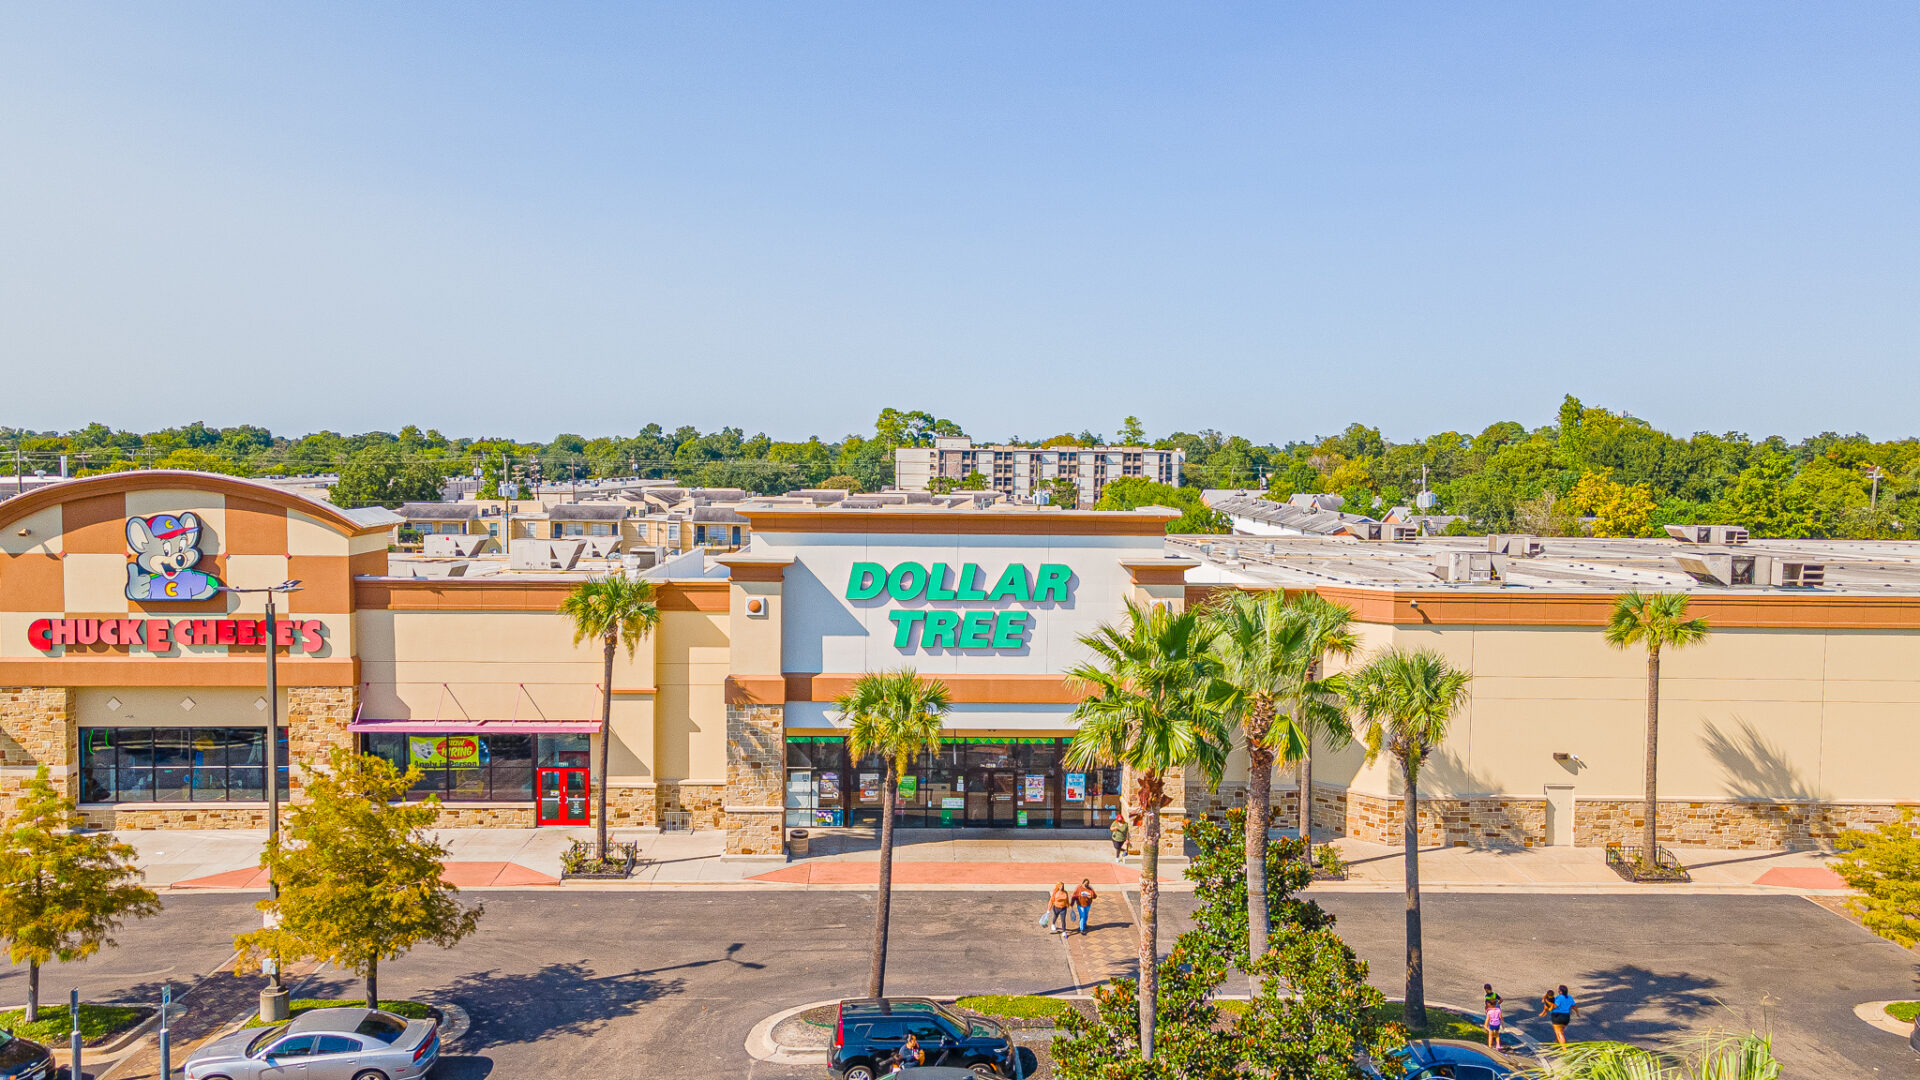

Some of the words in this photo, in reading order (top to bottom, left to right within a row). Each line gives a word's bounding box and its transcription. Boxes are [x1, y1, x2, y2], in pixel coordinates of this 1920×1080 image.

[165, 581, 178, 597] C
[845, 561, 1073, 602] DOLLAR
[27, 618, 145, 651] CHUCK
[147, 619, 172, 651] E
[888, 610, 1029, 649] TREE
